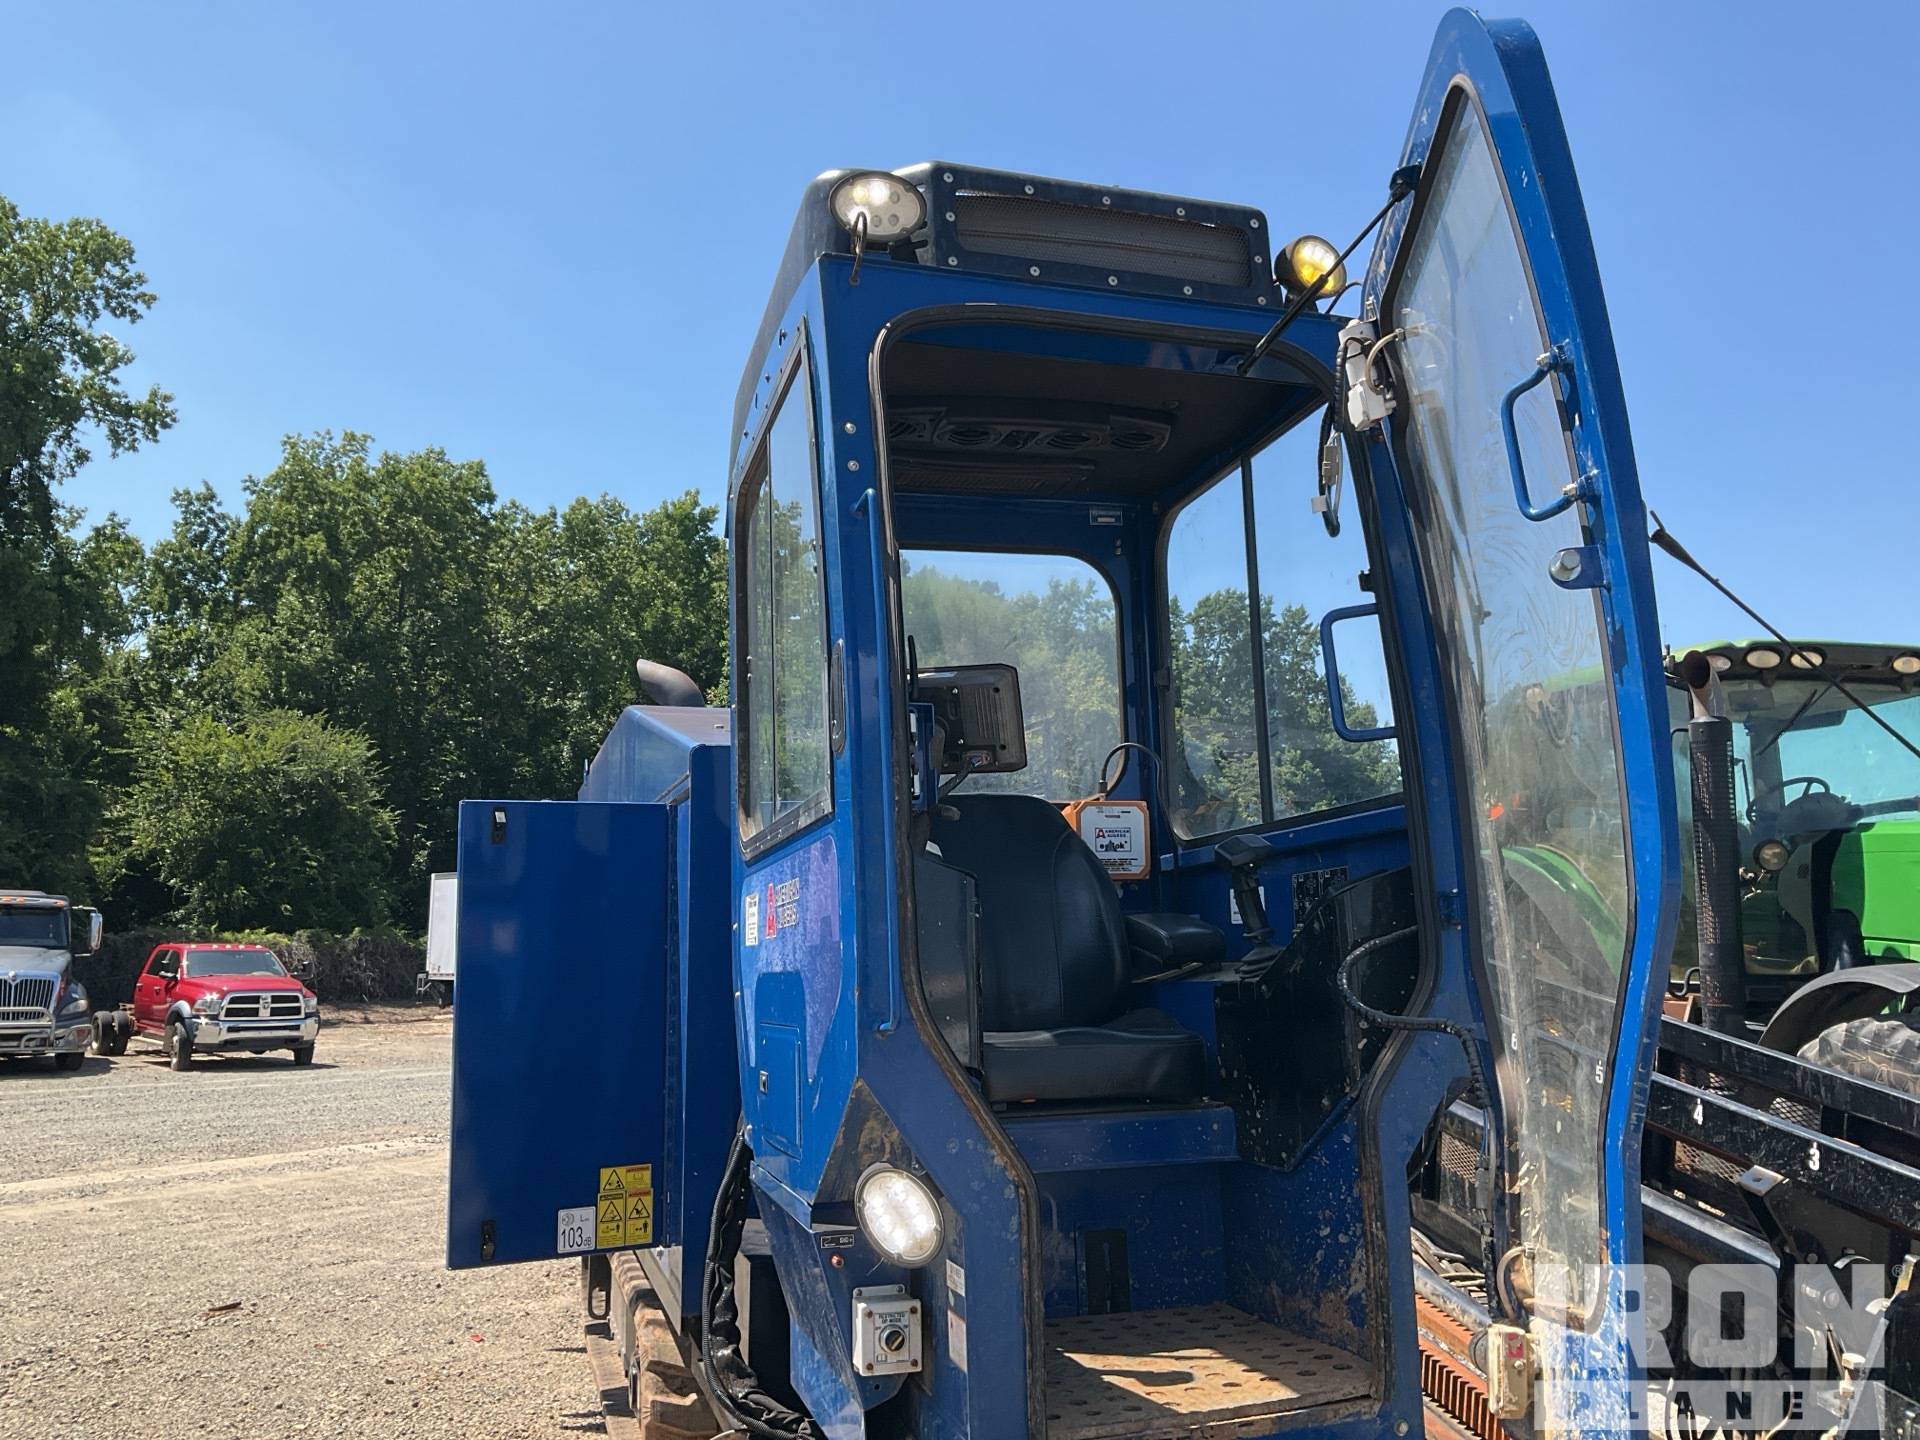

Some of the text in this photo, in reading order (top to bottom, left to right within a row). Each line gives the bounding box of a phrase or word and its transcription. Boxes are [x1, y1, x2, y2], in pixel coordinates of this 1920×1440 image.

[1511, 1032, 1518, 1051] 6
[1595, 1065, 1604, 1084] 5
[1693, 1104, 1704, 1125] 4
[1809, 1147, 1820, 1171] 3
[561, 1226, 583, 1249] 103
